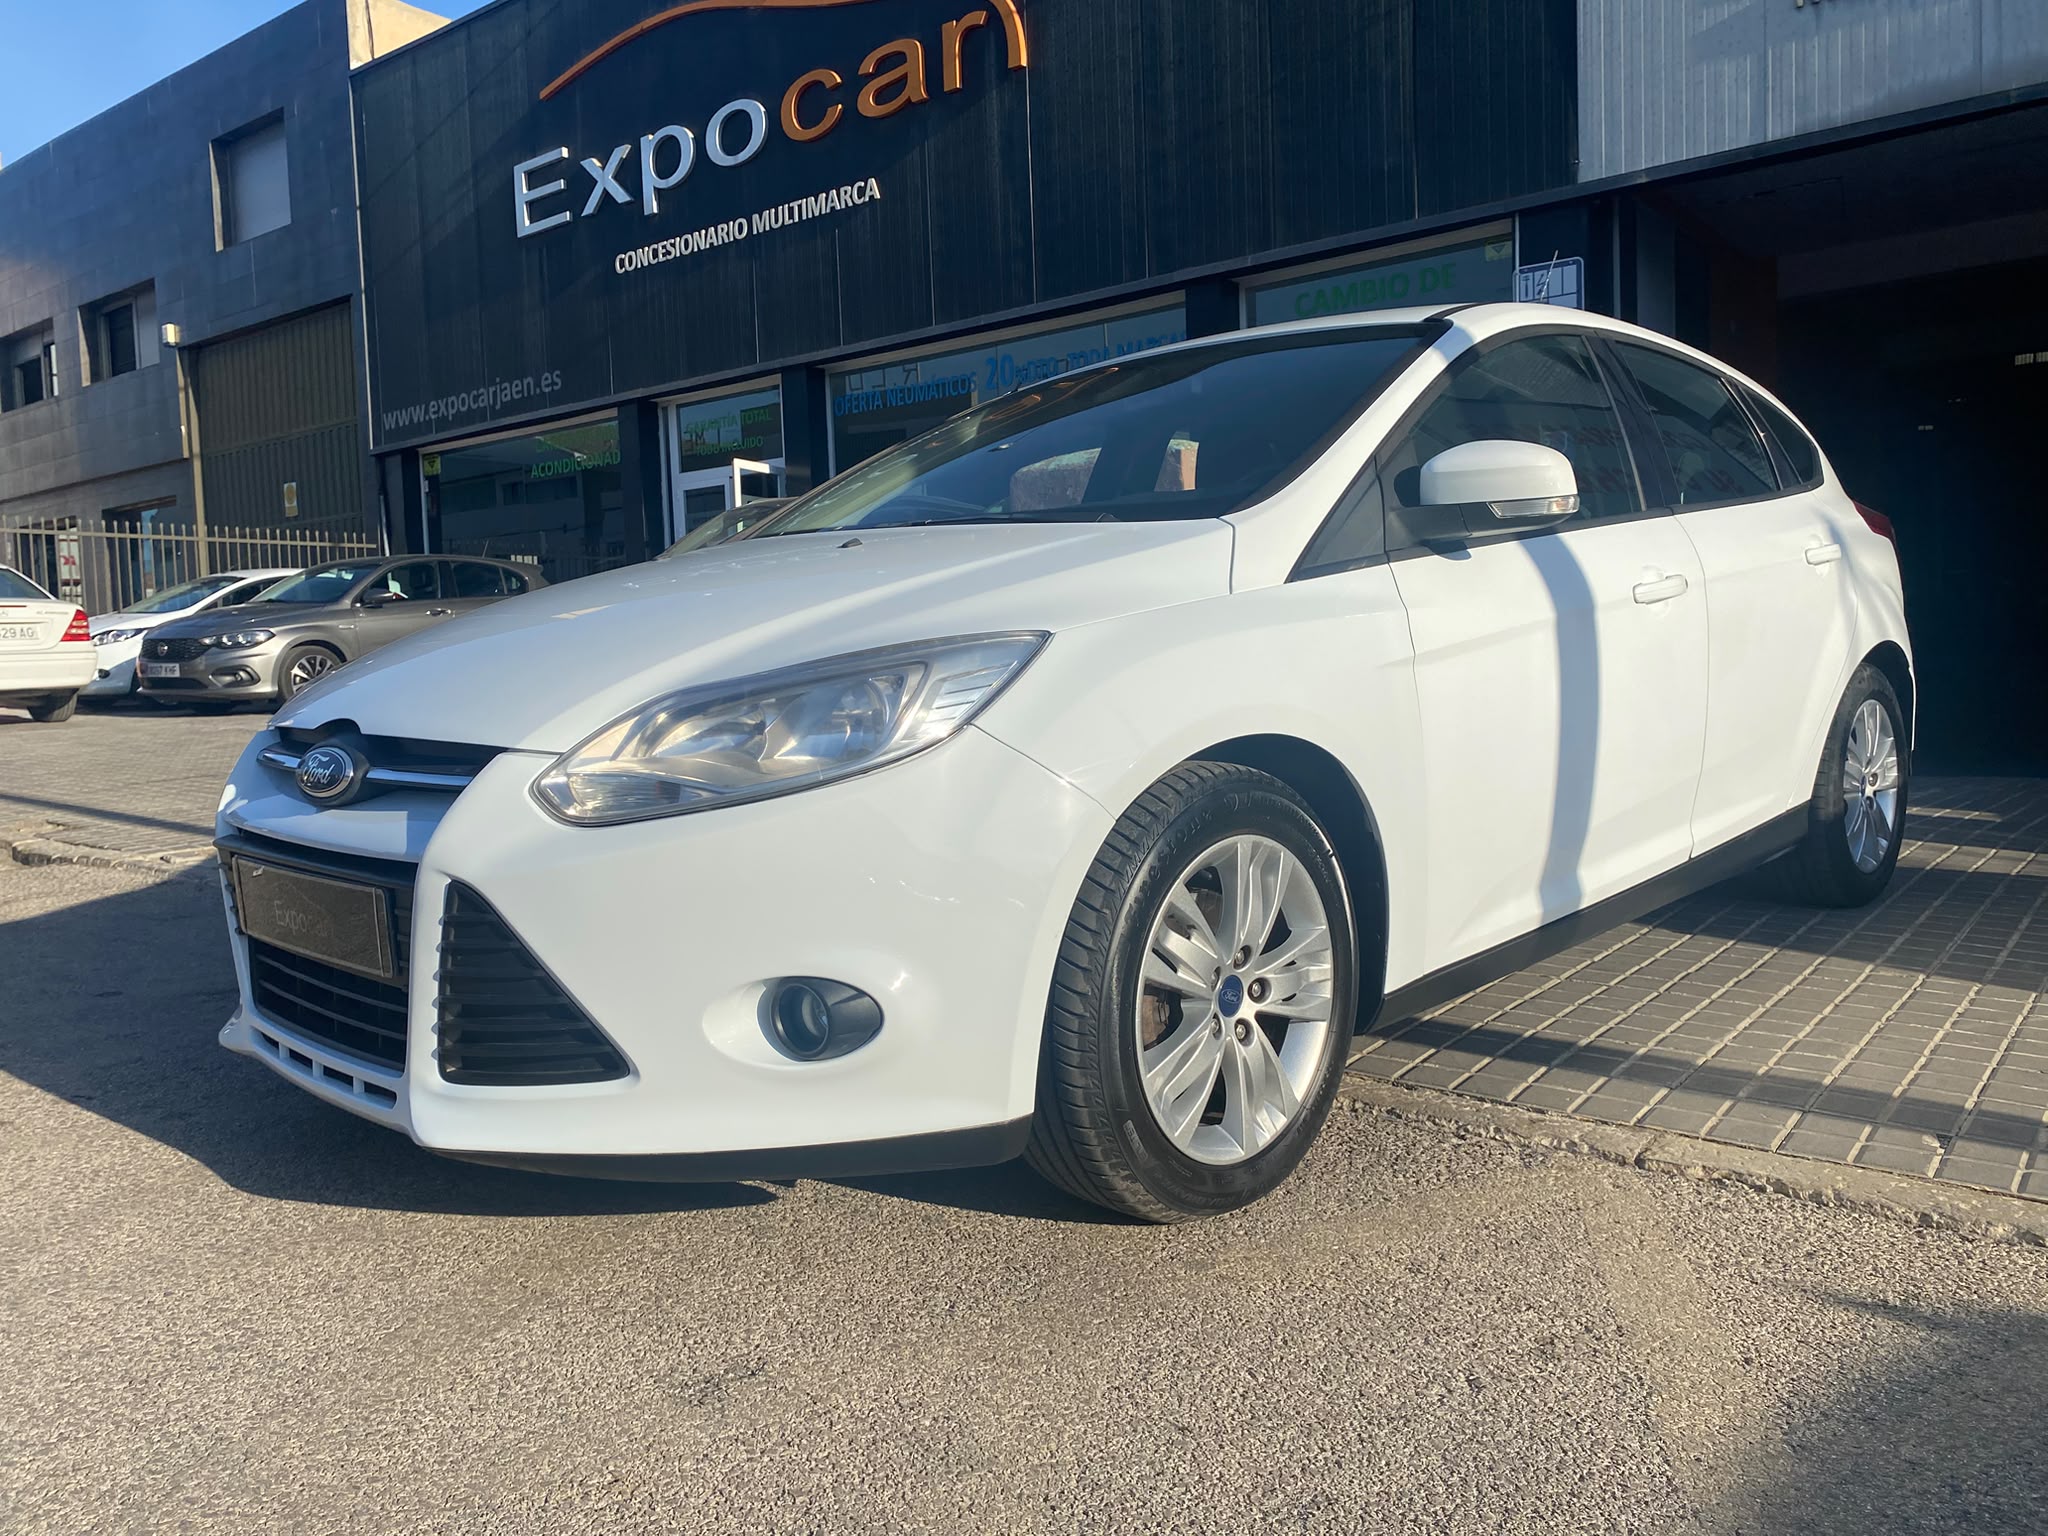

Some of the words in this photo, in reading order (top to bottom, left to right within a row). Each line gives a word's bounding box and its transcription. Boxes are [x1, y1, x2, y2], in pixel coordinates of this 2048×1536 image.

[513, 10, 989, 238] Expocar
[615, 217, 748, 275] CONCESIONARIO
[752, 177, 881, 236] MULTIMARCA
[1295, 272, 1410, 318] CAMBIO
[1419, 262, 1458, 294] DE
[383, 369, 562, 431] www.expocarjaen.es
[741, 407, 771, 425] TOTAL
[834, 391, 882, 417] OFERTA
[886, 371, 977, 408] NEUMÁTICOS
[303, 753, 336, 785] Ford
